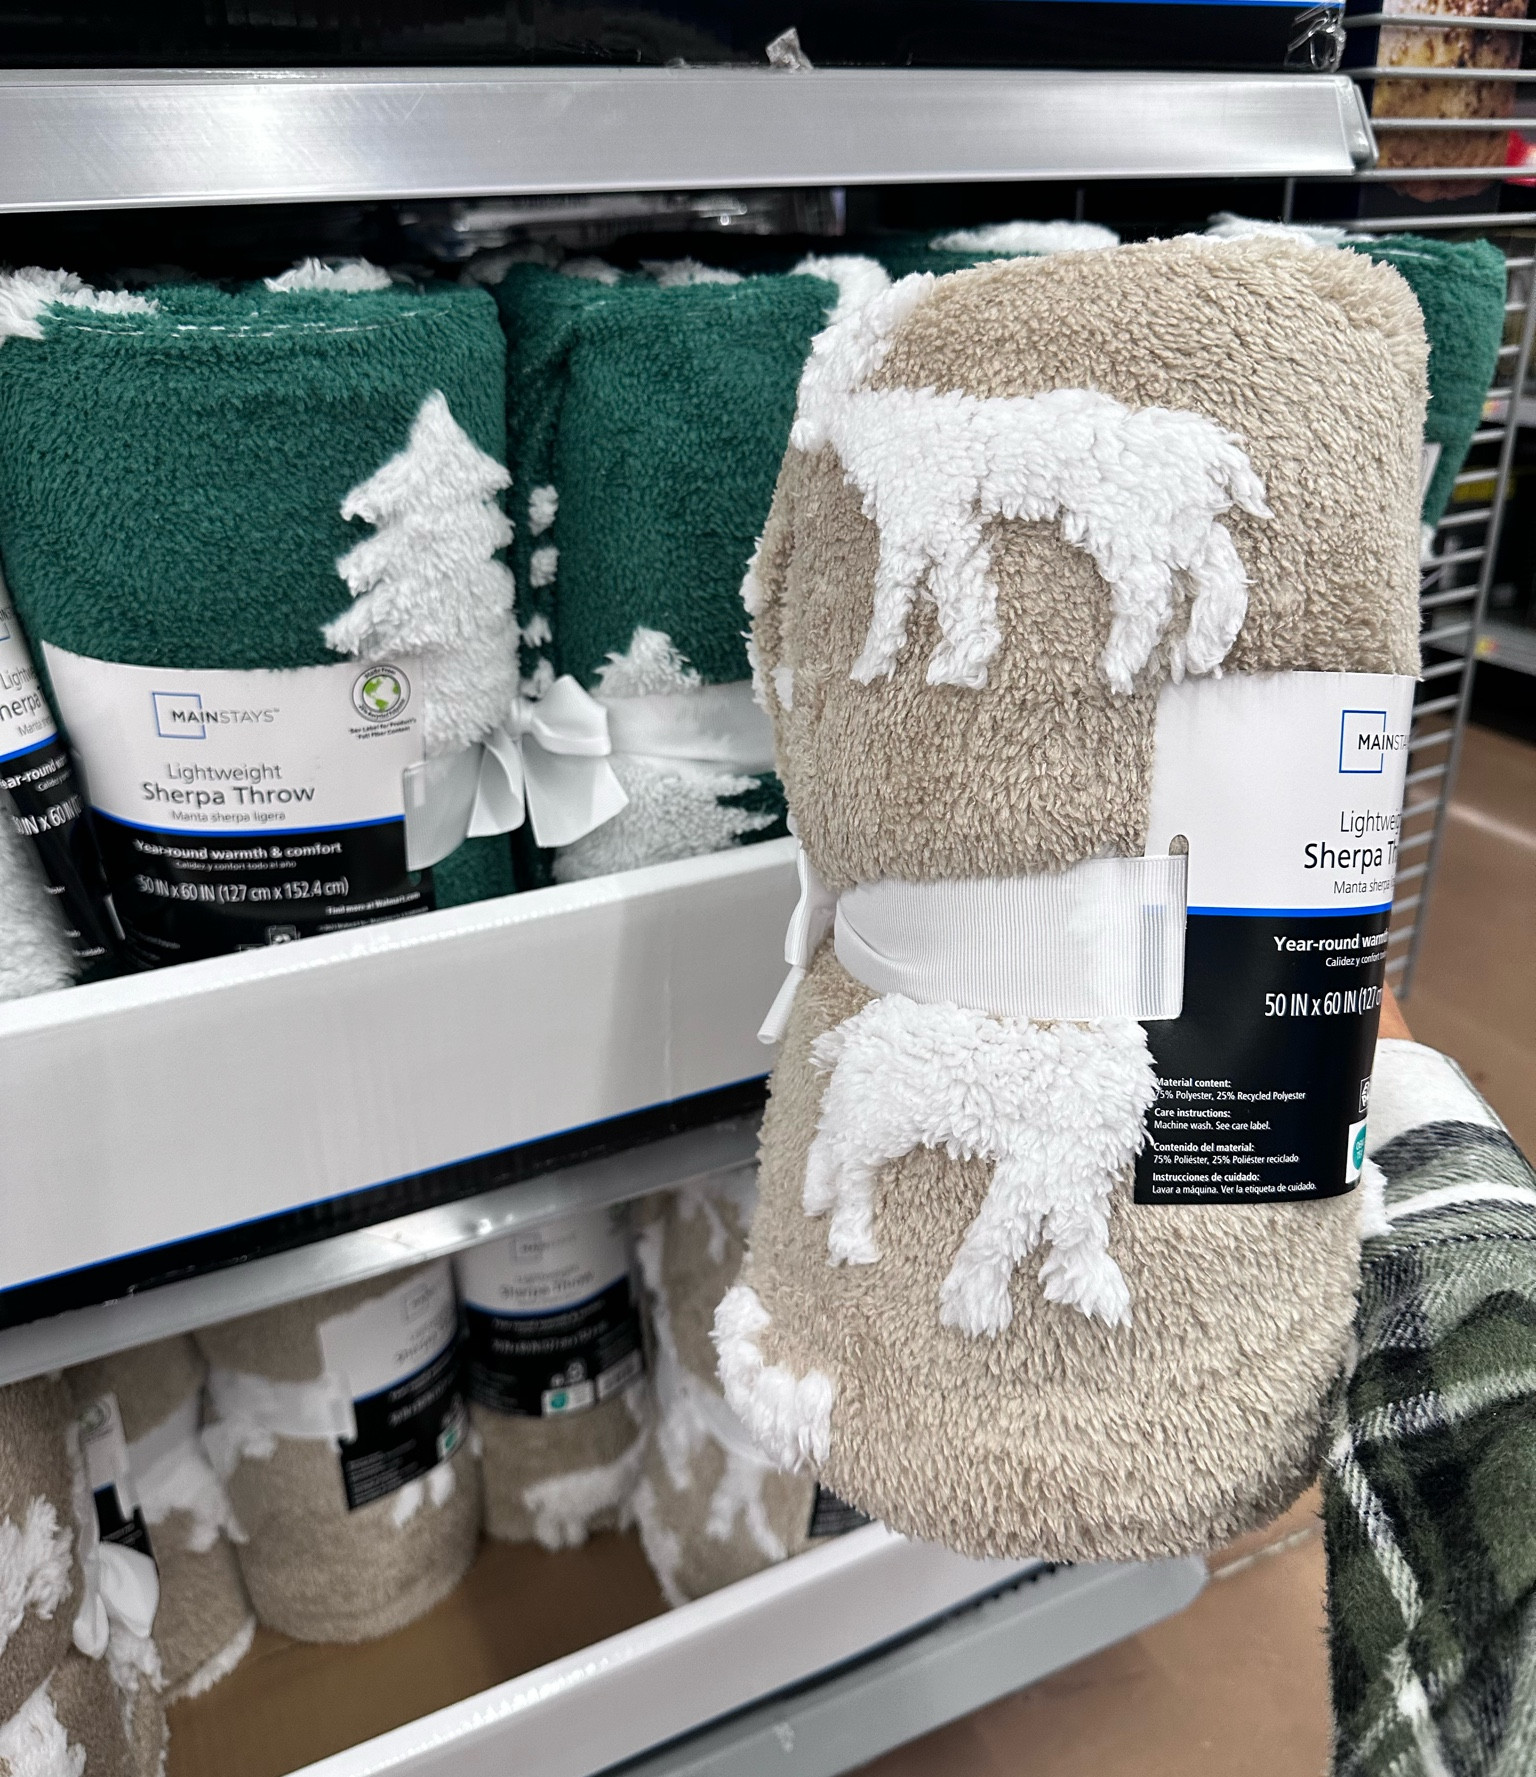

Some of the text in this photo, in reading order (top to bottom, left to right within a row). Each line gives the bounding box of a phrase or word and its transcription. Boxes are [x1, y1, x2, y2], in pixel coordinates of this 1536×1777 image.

[0, 759, 56, 789] ear-round
[167, 761, 283, 785] Lightweight
[142, 781, 316, 809] Sherpa Throw
[171, 810, 286, 823] Manta sherpa ligera
[133, 838, 343, 861] Year-round warmth & comfort
[1303, 842, 1383, 874] Sherpa
[154, 878, 170, 898] IN
[170, 884, 180, 899] x
[179, 882, 198, 901] 60
[199, 883, 216, 902] IN
[216, 884, 247, 904] (127
[248, 887, 272, 902] cm
[272, 885, 283, 900] x
[322, 876, 349, 897] cm)
[1333, 880, 1367, 894] Manta
[1274, 933, 1360, 952] Year-round
[1325, 956, 1355, 967] Calidez
[1264, 992, 1287, 1016] 50
[1290, 992, 1309, 1016] IN
[1311, 997, 1321, 1016] x
[1323, 991, 1341, 1015] 60
[1343, 989, 1358, 1014] IN
[1358, 985, 1377, 1015] (127
[1156, 1077, 1232, 1088] Material content:
[1155, 1090, 1306, 1102] 75% Polyester, 25% Recycled Polyester
[1154, 1107, 1231, 1118] Care instructions:
[1154, 1120, 1271, 1130] Machine wash. See care label.
[1153, 1142, 1255, 1152] Contenido del material:
[1153, 1154, 1300, 1165] 75% Poliéster, 25% Poliéster reciclado
[1152, 1172, 1260, 1182] Instrucciones de cuidado:
[1152, 1185, 1174, 1194] Lavar
[1182, 1185, 1219, 1196] máquina.
[1220, 1185, 1235, 1193] Ver
[1235, 1184, 1244, 1193] la
[1244, 1184, 1276, 1195] etiqueta
[1276, 1183, 1287, 1193] de
[1287, 1181, 1317, 1191] cuidado.
